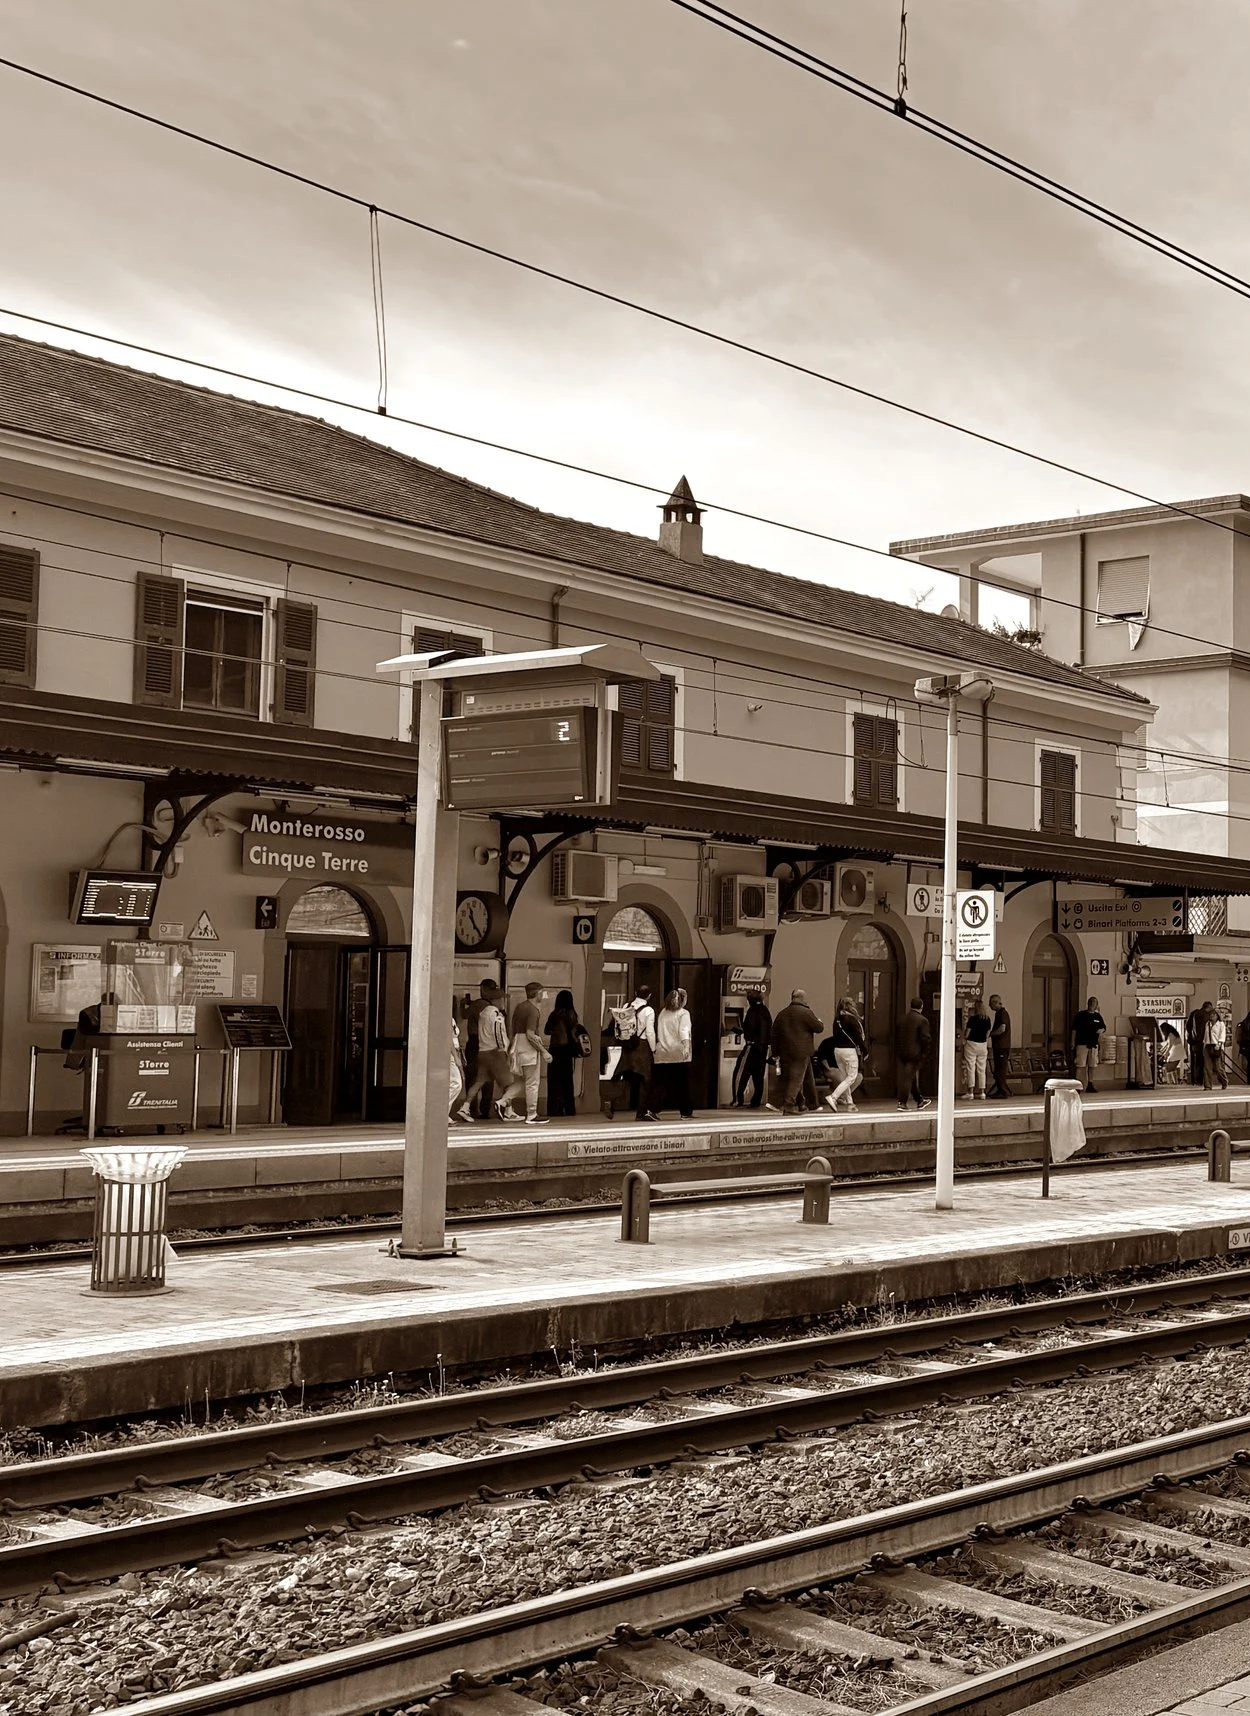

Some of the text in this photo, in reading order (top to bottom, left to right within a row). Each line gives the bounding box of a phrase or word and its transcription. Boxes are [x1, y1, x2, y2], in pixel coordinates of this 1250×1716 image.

[556, 721, 570, 741] 2
[251, 813, 365, 842] Monterosso
[250, 846, 369, 873] Cinque Terre
[1088, 903, 1128, 912] Uscita Exit
[1088, 920, 1113, 928] Binari
[1115, 919, 1150, 928] Platforms
[126, 1040, 184, 1048] Assistenza Clienti
[139, 1060, 170, 1068] 5Terre
[732, 1136, 742, 1144] Do
[784, 1132, 808, 1142] railway
[583, 1145, 611, 1154] Vietato
[612, 1143, 658, 1152] attraversare
[664, 1140, 685, 1149] binari
